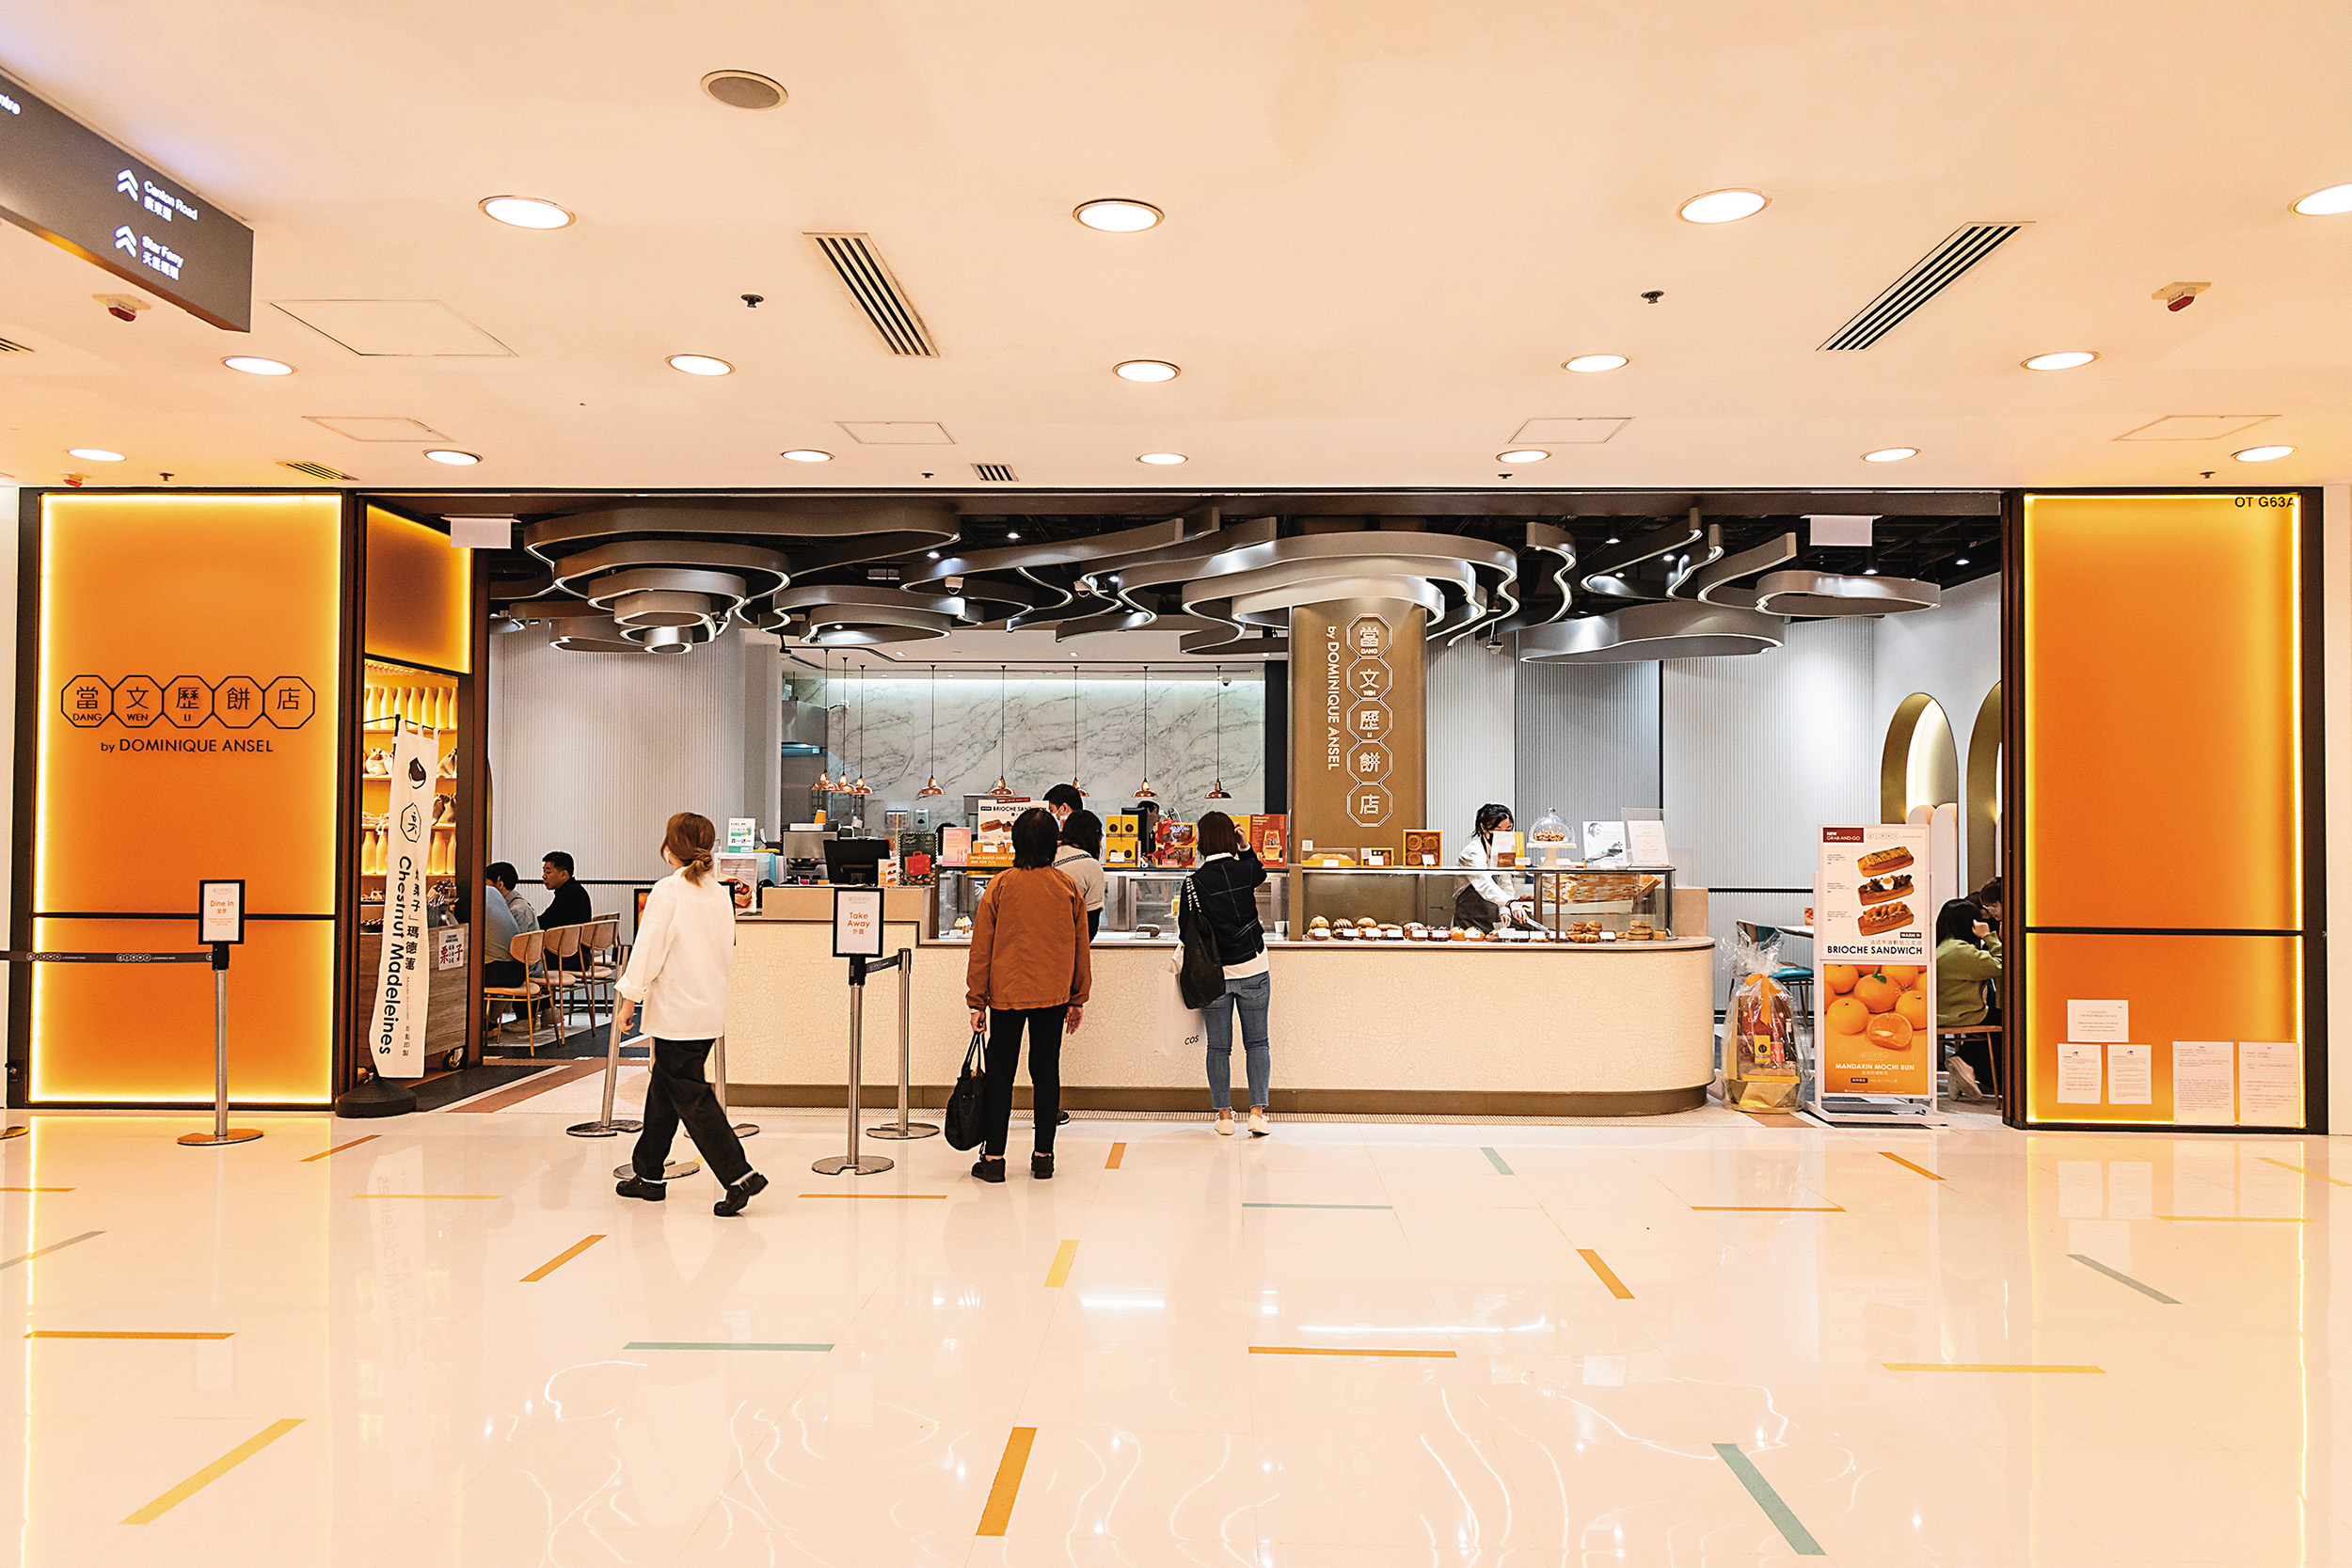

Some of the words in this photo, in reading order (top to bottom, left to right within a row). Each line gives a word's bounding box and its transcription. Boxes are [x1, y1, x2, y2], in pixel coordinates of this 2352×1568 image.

[175, 198, 199, 221] Road
[2234, 497, 2253, 508] OT
[2258, 497, 2296, 508] G63A
[1326, 626, 1337, 639] by
[1327, 641, 1340, 723] DOMINIQUE
[72, 713, 103, 721] DANG
[126, 713, 149, 721] WEN
[183, 713, 191, 721] LI
[101, 742, 115, 753] by
[119, 738, 217, 752] DOMINIQUE
[222, 739, 273, 752] ANSEL
[1327, 727, 1340, 770] ANSEL
[392, 856, 412, 939] Chestnut
[847, 920, 870, 928] Away
[1827, 945, 1868, 954] BRIOCHE
[1870, 945, 1923, 955] SANDWICH
[379, 942, 405, 1054] Madeleines
[1184, 1035, 1200, 1045] COS
